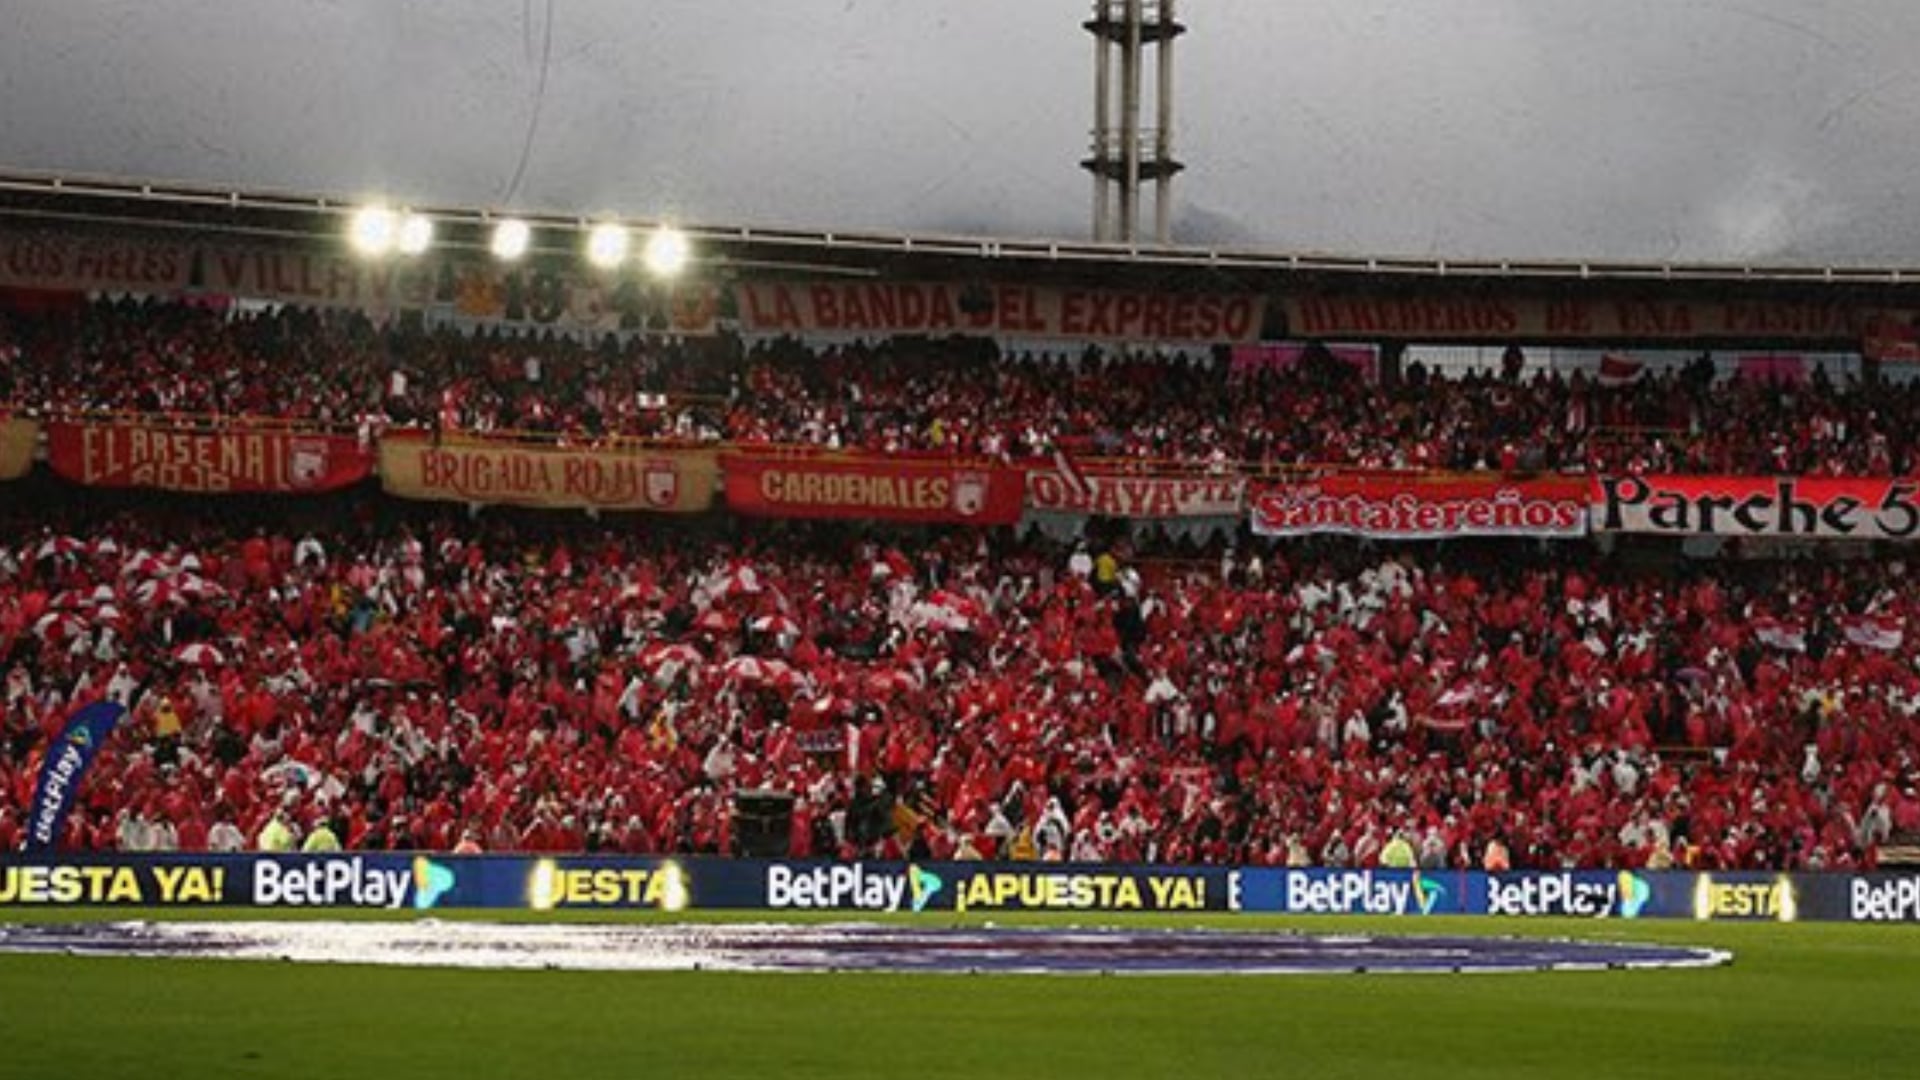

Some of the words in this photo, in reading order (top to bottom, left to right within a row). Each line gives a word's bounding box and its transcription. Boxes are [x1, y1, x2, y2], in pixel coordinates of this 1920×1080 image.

[745, 284, 800, 327] LA
[811, 284, 954, 329] BANDA
[1060, 292, 1251, 338] EXPRESO
[83, 428, 123, 485] EL
[130, 430, 292, 490] ARSENAL
[419, 449, 553, 497] BRIGADA
[562, 455, 638, 503] ROJA
[761, 470, 949, 509] CARDENALES
[1256, 489, 1579, 531] Santafereños
[1603, 479, 1863, 533] Parche
[36, 744, 83, 843] BetPlay
[152, 866, 224, 903] YA!
[254, 856, 411, 909] BetPlay
[768, 862, 906, 912] BetPlay
[956, 873, 1143, 912] ¡APUESTA
[1148, 877, 1205, 908] YA!
[1286, 870, 1410, 916] BetPlay
